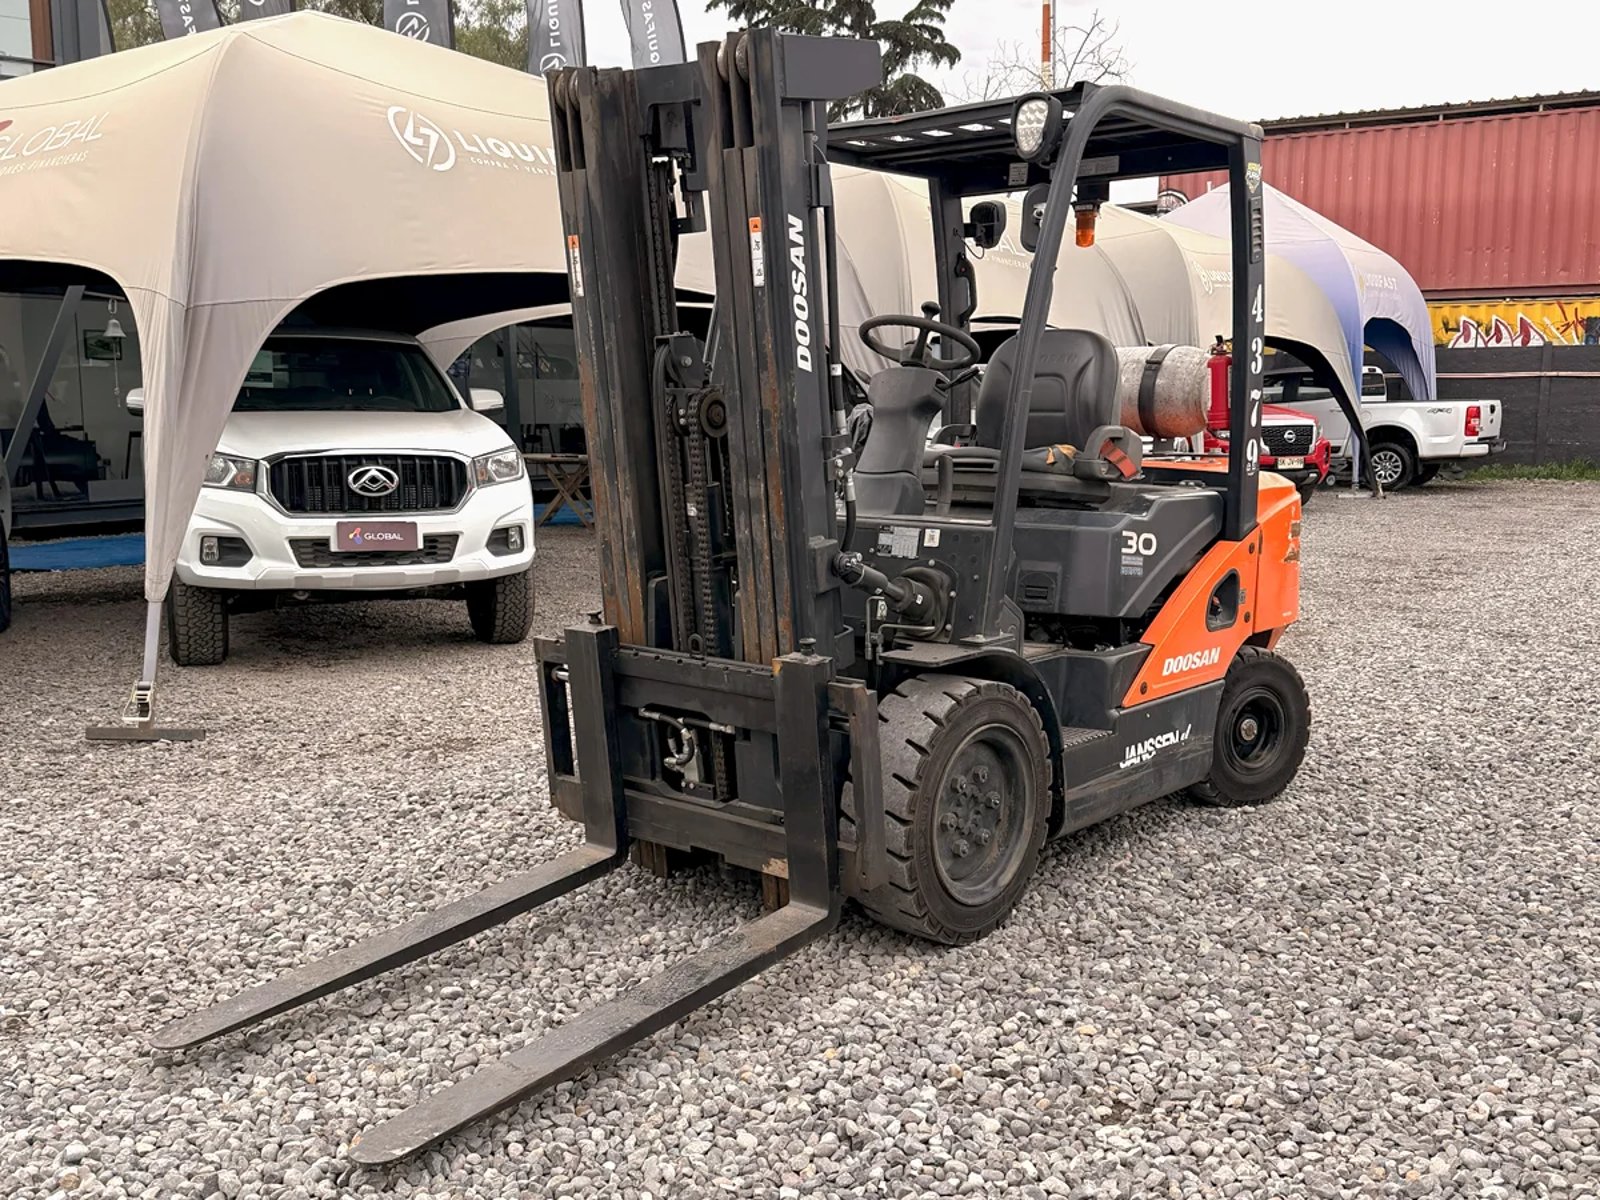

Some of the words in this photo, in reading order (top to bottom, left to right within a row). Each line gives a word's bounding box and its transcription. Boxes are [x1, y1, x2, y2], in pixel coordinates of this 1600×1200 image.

[787, 213, 813, 373] DOOSAN
[363, 532, 404, 541] GLOBAL
[1121, 530, 1157, 556] 30
[1161, 647, 1221, 677] DOOSAN
[1119, 729, 1180, 769] JANSSEN
